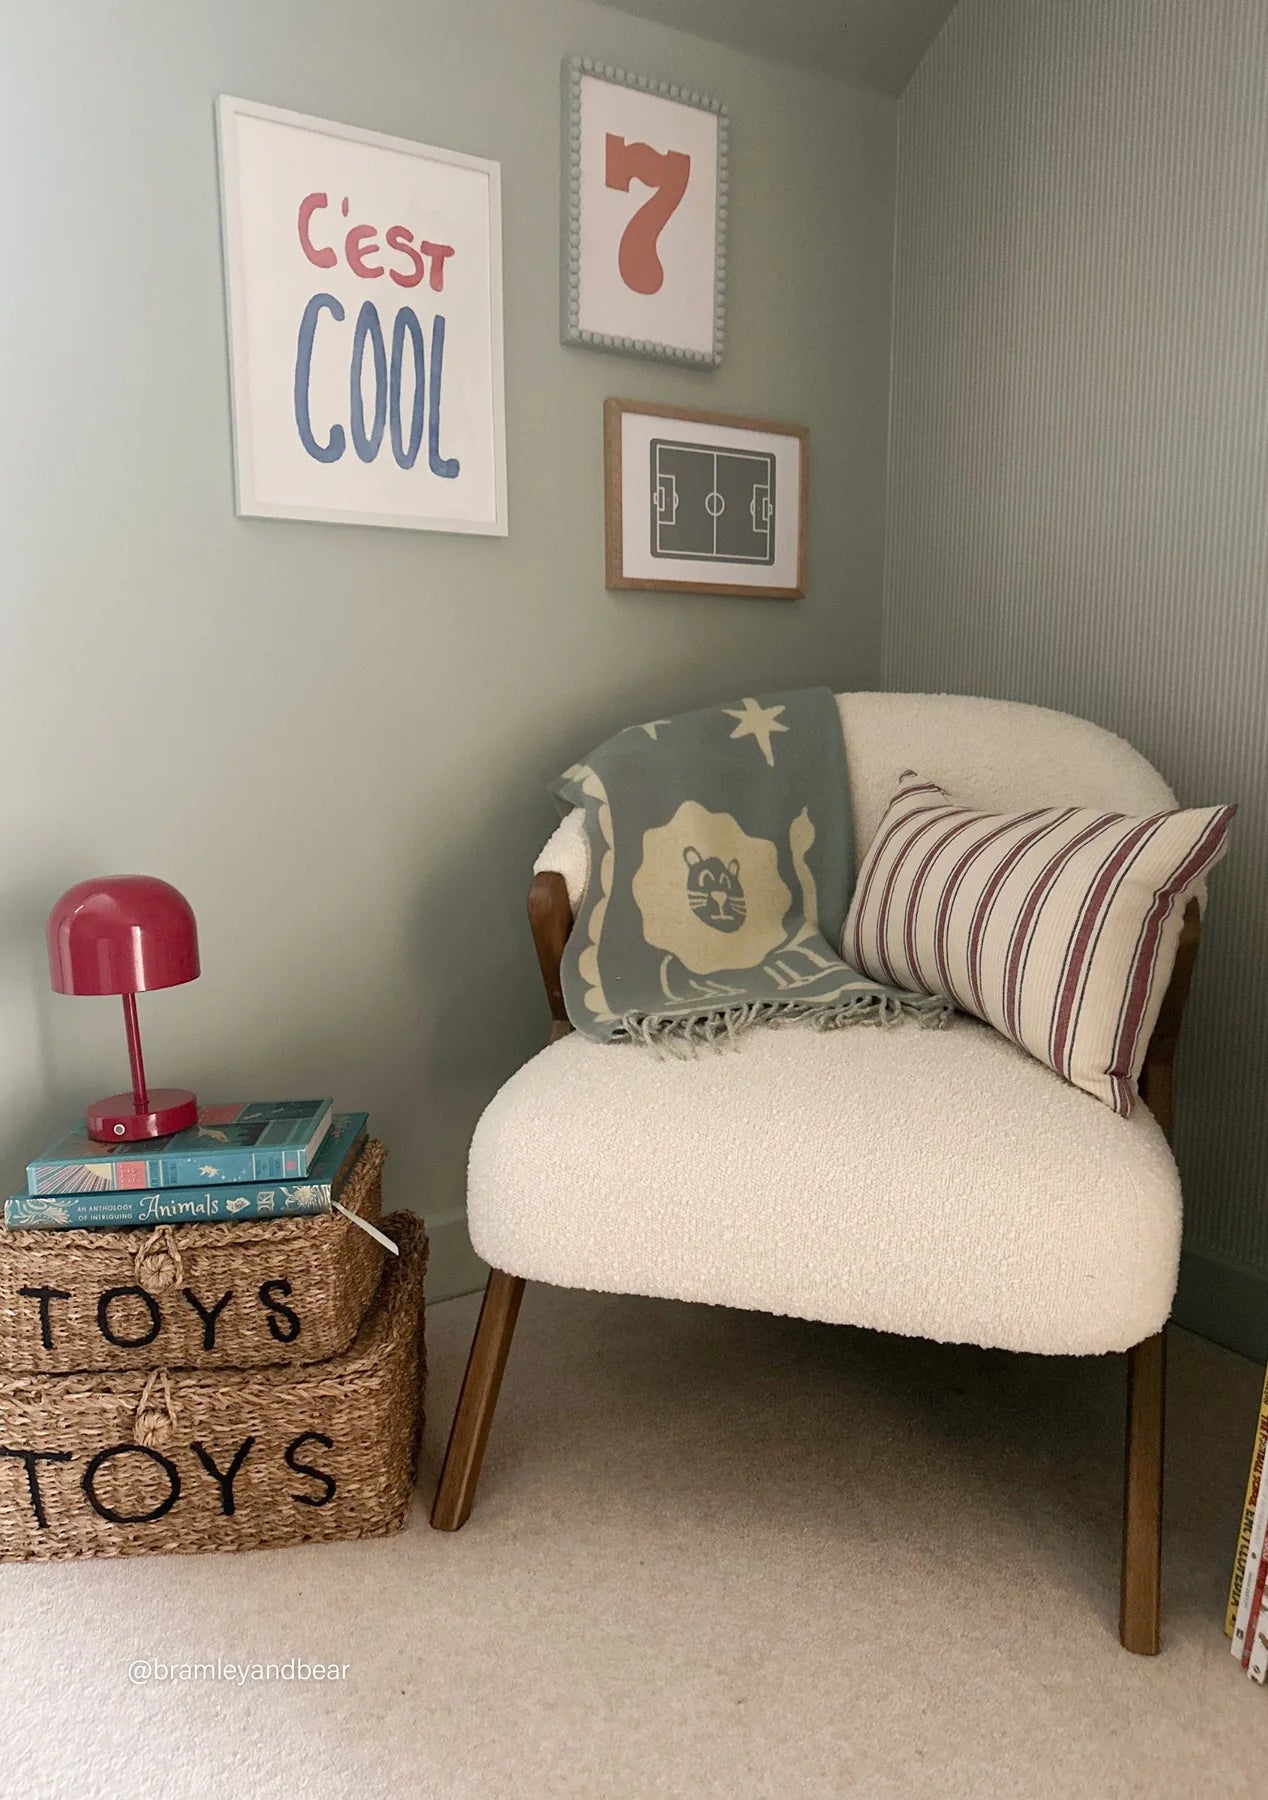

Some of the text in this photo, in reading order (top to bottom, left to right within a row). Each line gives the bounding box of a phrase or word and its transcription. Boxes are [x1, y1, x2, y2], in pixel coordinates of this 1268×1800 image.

[298, 192, 455, 292] C'EST
[605, 132, 691, 295] 7
[294, 293, 460, 478] COOL
[77, 1204, 133, 1213] AN ANTHOLOGY
[138, 1194, 219, 1221] Animals
[20, 1277, 301, 1351] TOYS
[0, 1432, 336, 1528] TOYS
